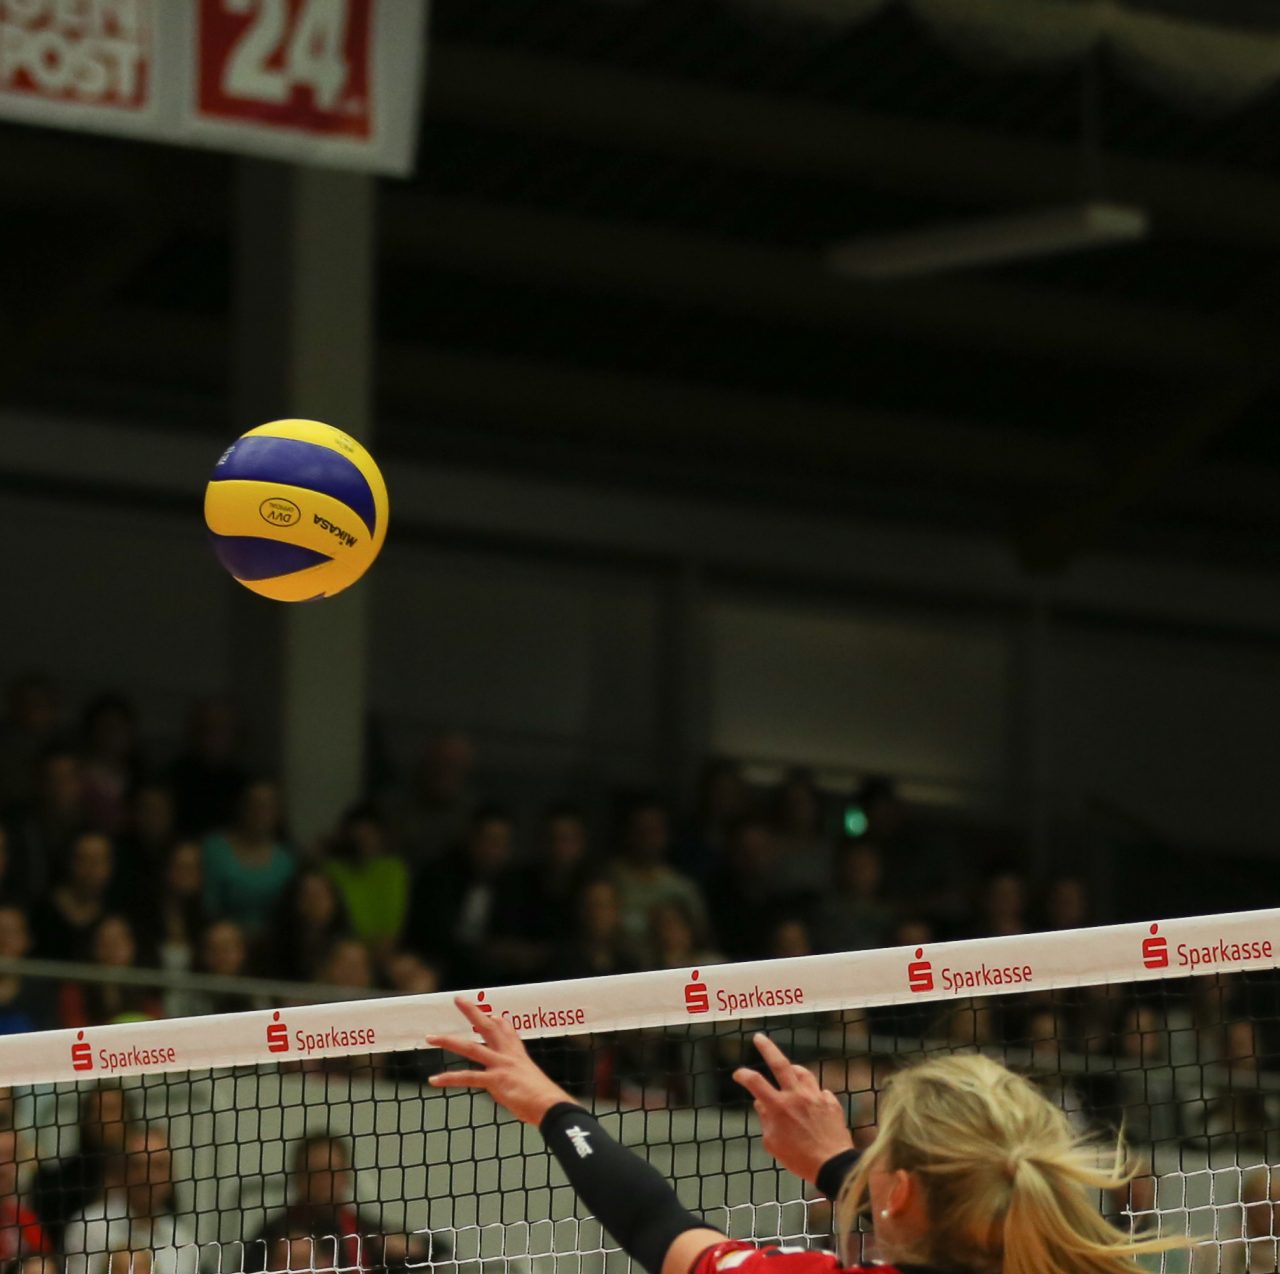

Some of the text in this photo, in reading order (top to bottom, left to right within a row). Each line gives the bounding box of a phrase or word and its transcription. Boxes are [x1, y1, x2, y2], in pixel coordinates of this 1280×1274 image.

[267, 509, 293, 523] DVV
[313, 513, 358, 548] MIKASA
[1176, 938, 1274, 966] Sparkasse
[941, 962, 1033, 991] Sparkasse
[716, 984, 804, 1013] Sparkasse
[295, 1026, 375, 1052] Sparkasse
[99, 1044, 176, 1070] Sparkasse
